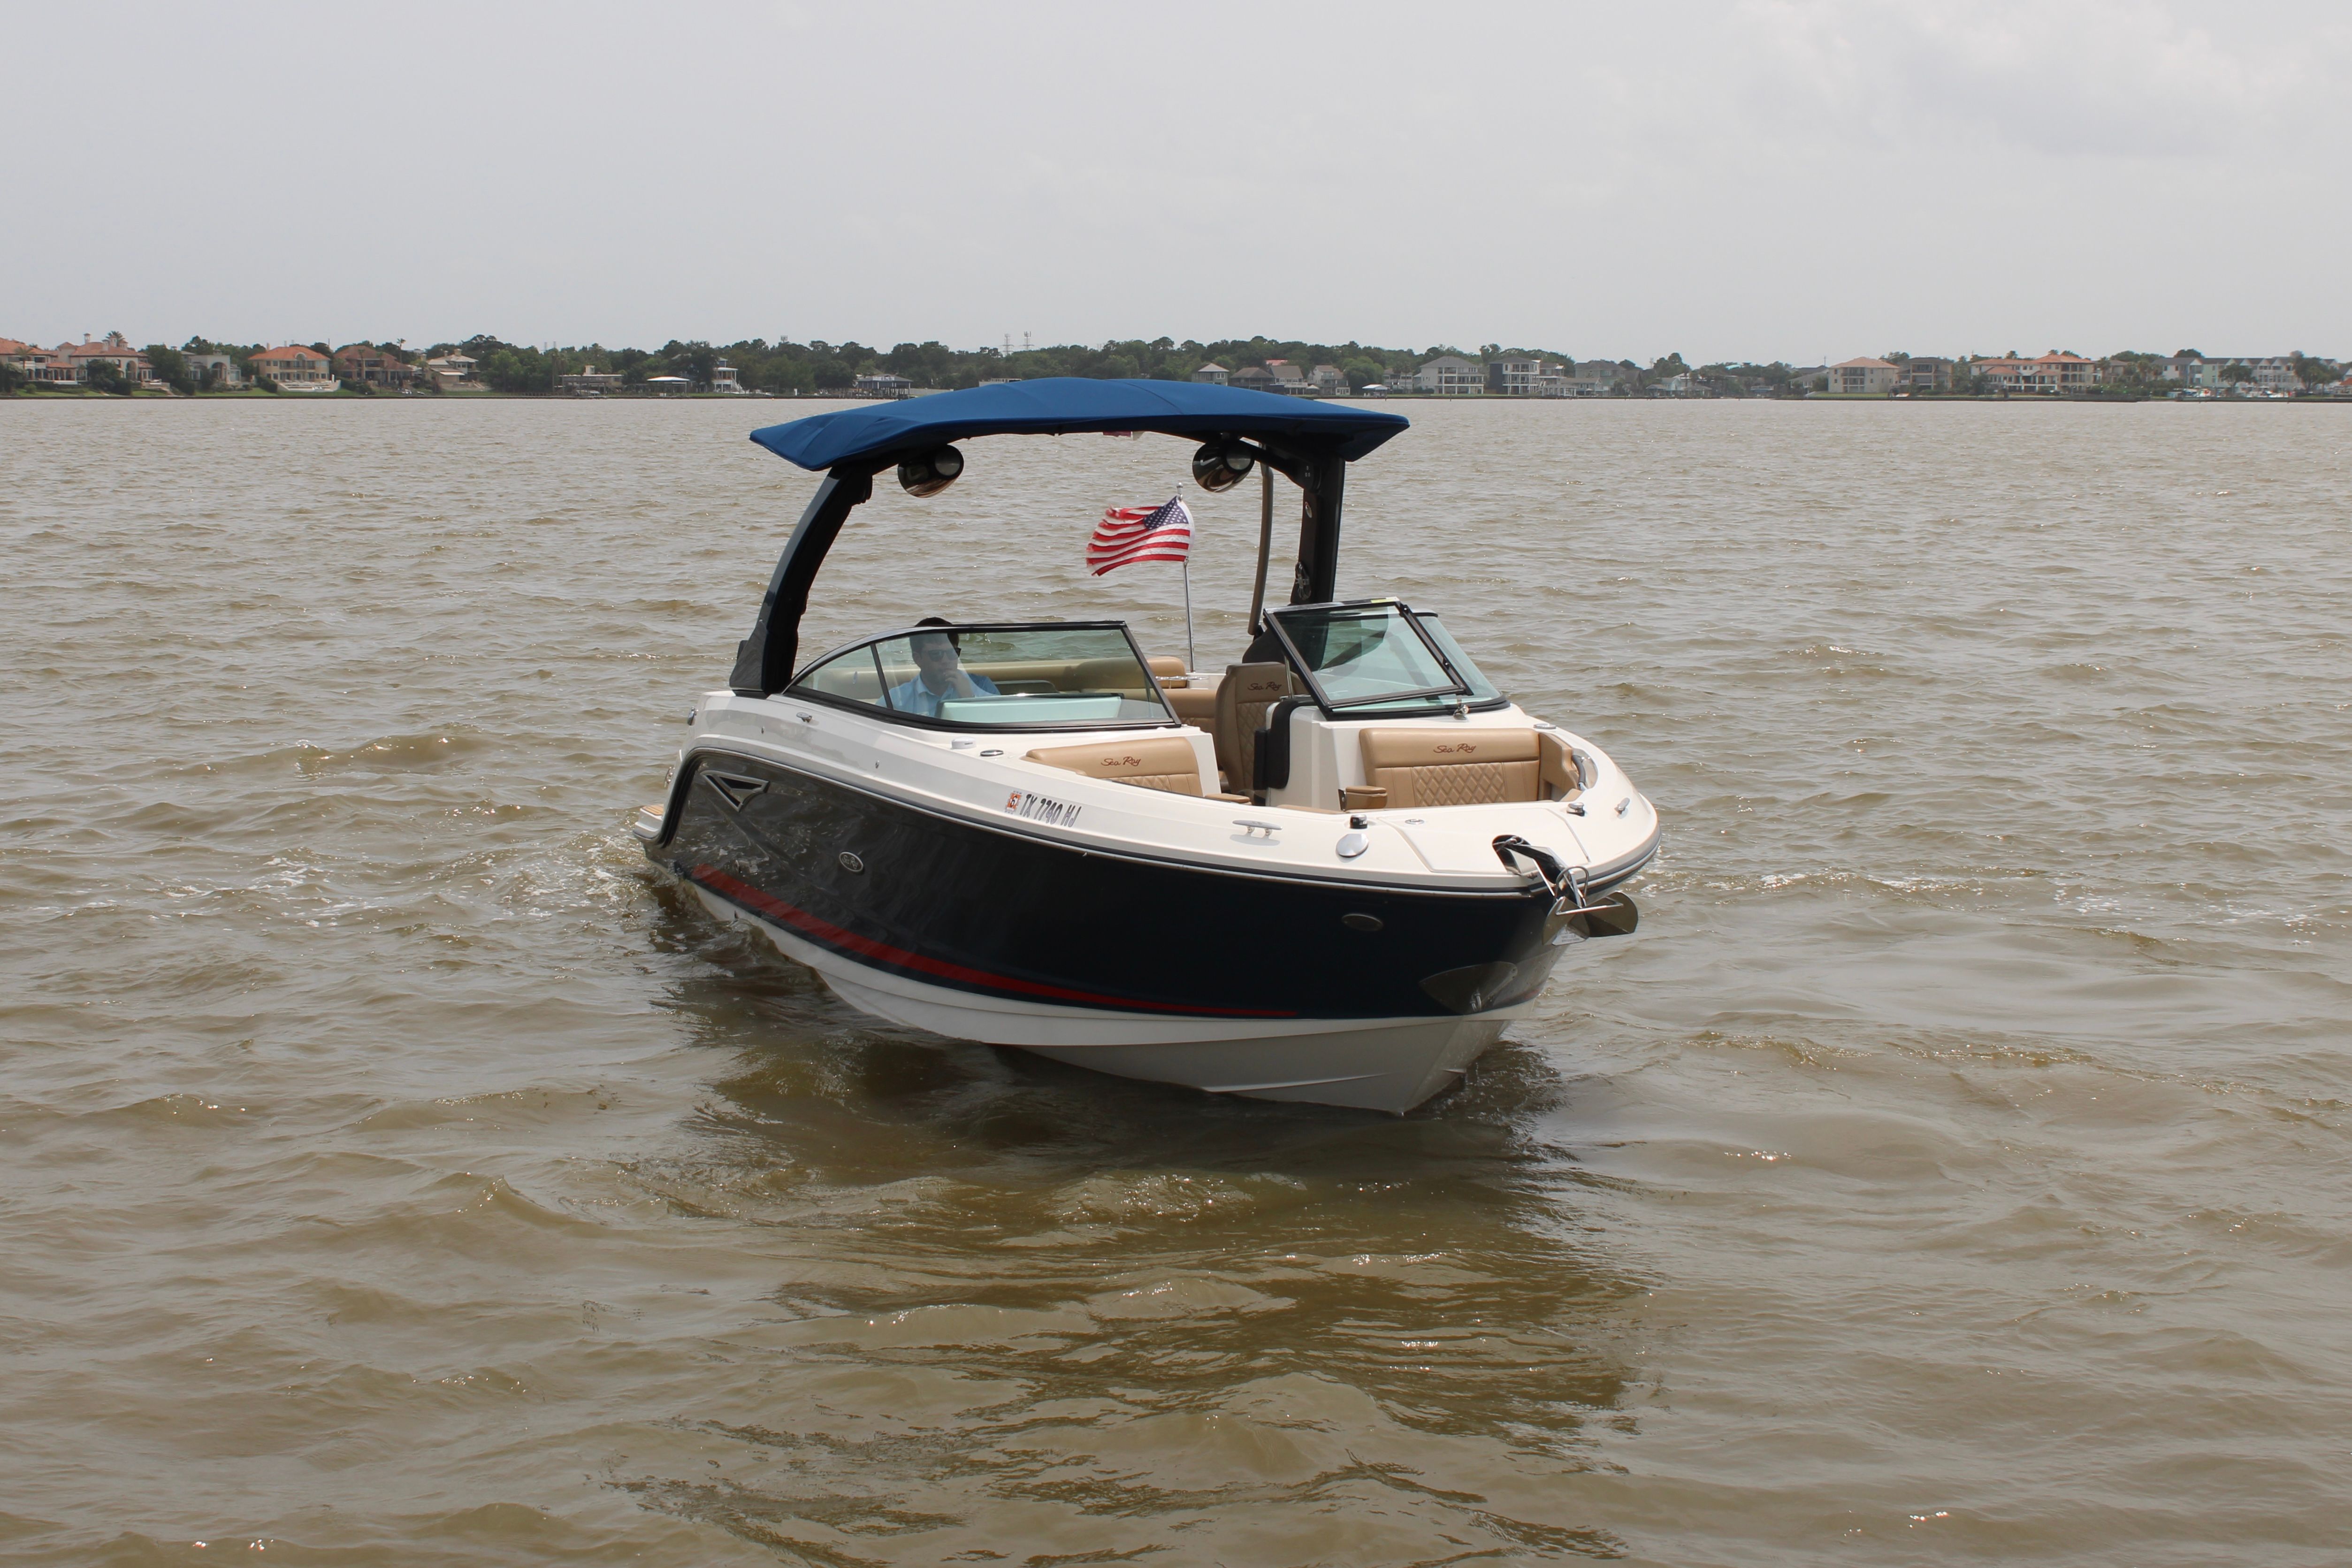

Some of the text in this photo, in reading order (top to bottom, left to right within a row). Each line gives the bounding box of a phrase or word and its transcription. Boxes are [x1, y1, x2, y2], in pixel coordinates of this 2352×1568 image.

[1265, 681, 1282, 691] Ray
[1456, 743, 1476, 753] Ray
[1123, 756, 1141, 766] Ray
[1020, 794, 1038, 818] TX
[1061, 804, 1082, 827] HJ
